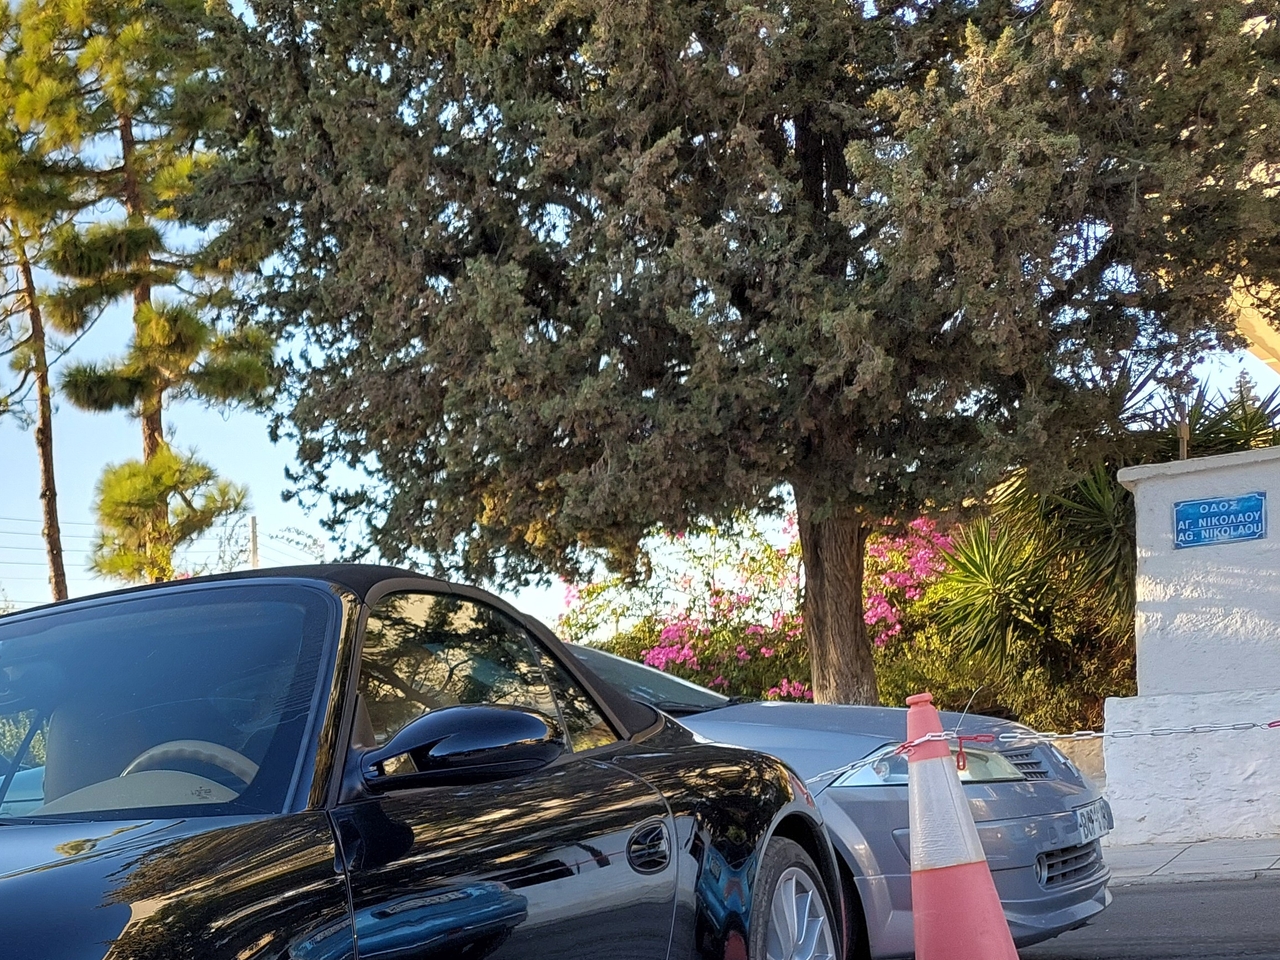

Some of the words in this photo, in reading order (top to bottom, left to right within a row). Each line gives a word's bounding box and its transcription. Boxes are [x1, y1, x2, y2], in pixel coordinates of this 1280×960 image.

[1199, 500, 1238, 513] ΟΔΟΣ
[1178, 519, 1193, 530] ΑΓ.
[1198, 511, 1261, 528] ΝΙΚΟΛΑΟΥ
[1178, 531, 1197, 541] AG.
[1201, 523, 1262, 539] NIKOLAOU
